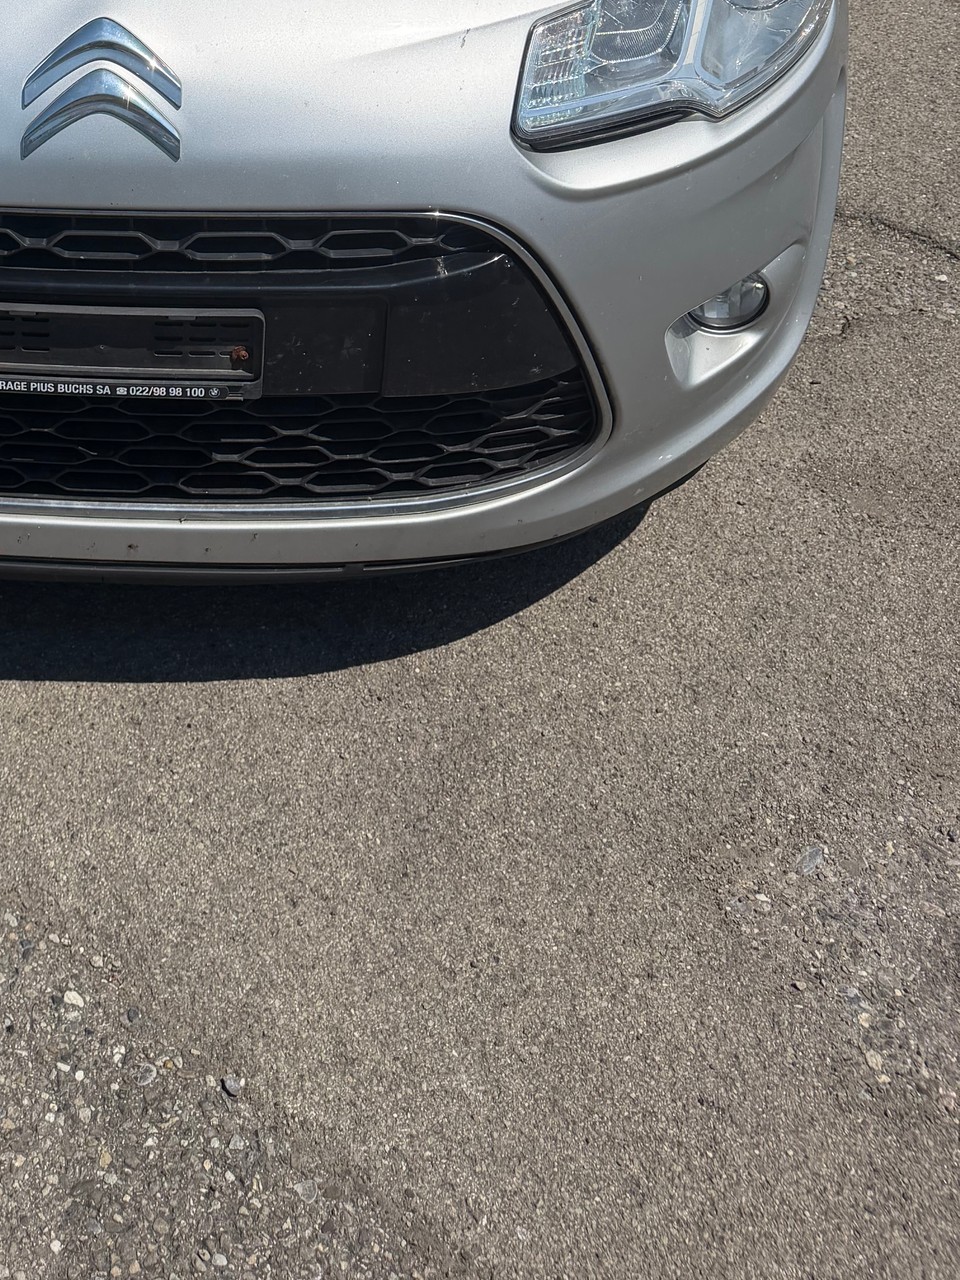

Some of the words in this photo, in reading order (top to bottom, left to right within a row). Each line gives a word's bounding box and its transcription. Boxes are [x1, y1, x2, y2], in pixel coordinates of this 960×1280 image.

[30, 382, 55, 393] PIUS
[57, 384, 94, 394] BUCHS
[95, 385, 111, 395] SA
[129, 386, 167, 397] 022/98
[169, 387, 183, 397] 98
[186, 387, 205, 398] 100
